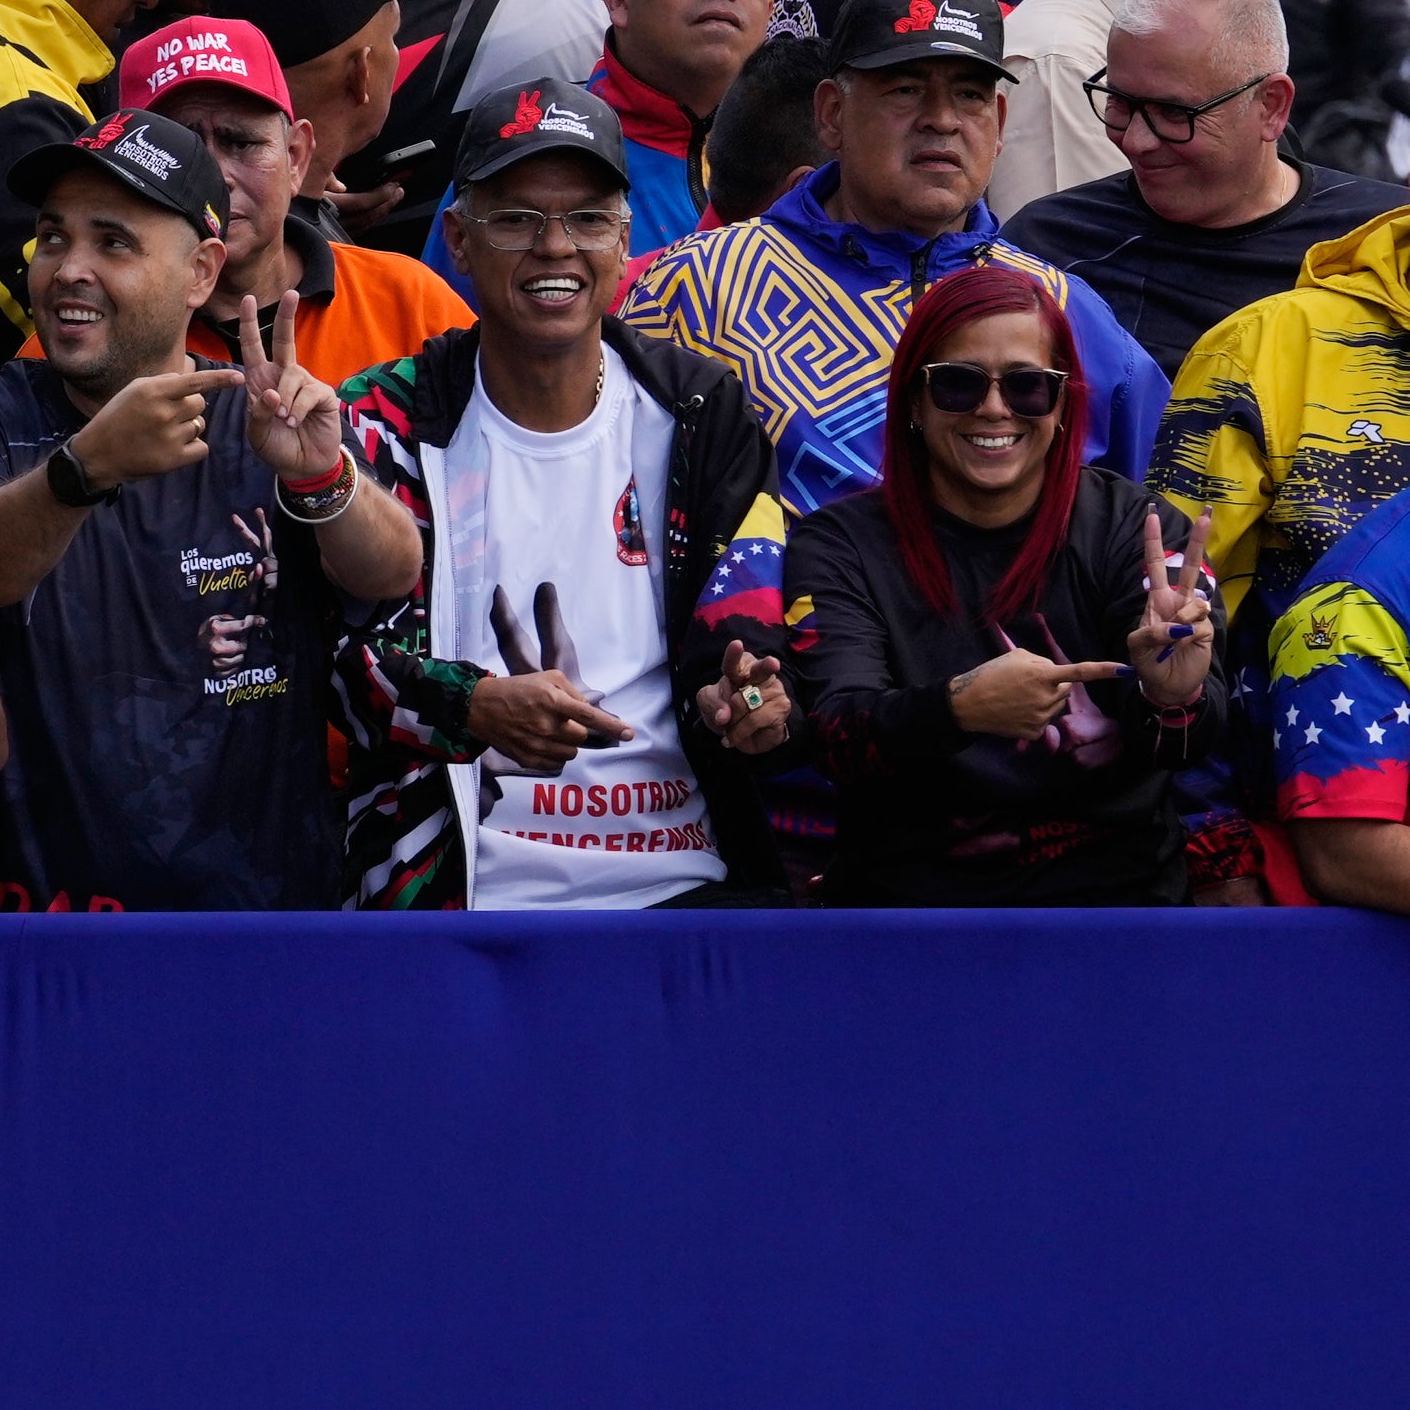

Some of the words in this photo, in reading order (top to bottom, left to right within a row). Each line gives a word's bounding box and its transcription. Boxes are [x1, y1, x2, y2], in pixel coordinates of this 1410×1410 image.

[933, 22, 983, 40] VENCEREMOS
[935, 16, 978, 30] NOSOTROS
[157, 38, 183, 63] NO
[186, 32, 232, 52] WAR
[146, 62, 178, 94] YES
[180, 54, 248, 77] PEACE!
[538, 123, 595, 140] VENCEREMOS
[541, 117, 587, 130] NOSOTROS
[114, 145, 169, 180] VENCEREMOS
[123, 140, 168, 169] NOSOTROS
[181, 547, 199, 560] Los
[181, 551, 254, 576] queremos
[199, 566, 248, 596] Vuelta
[533, 779, 692, 818] NOSOTROS
